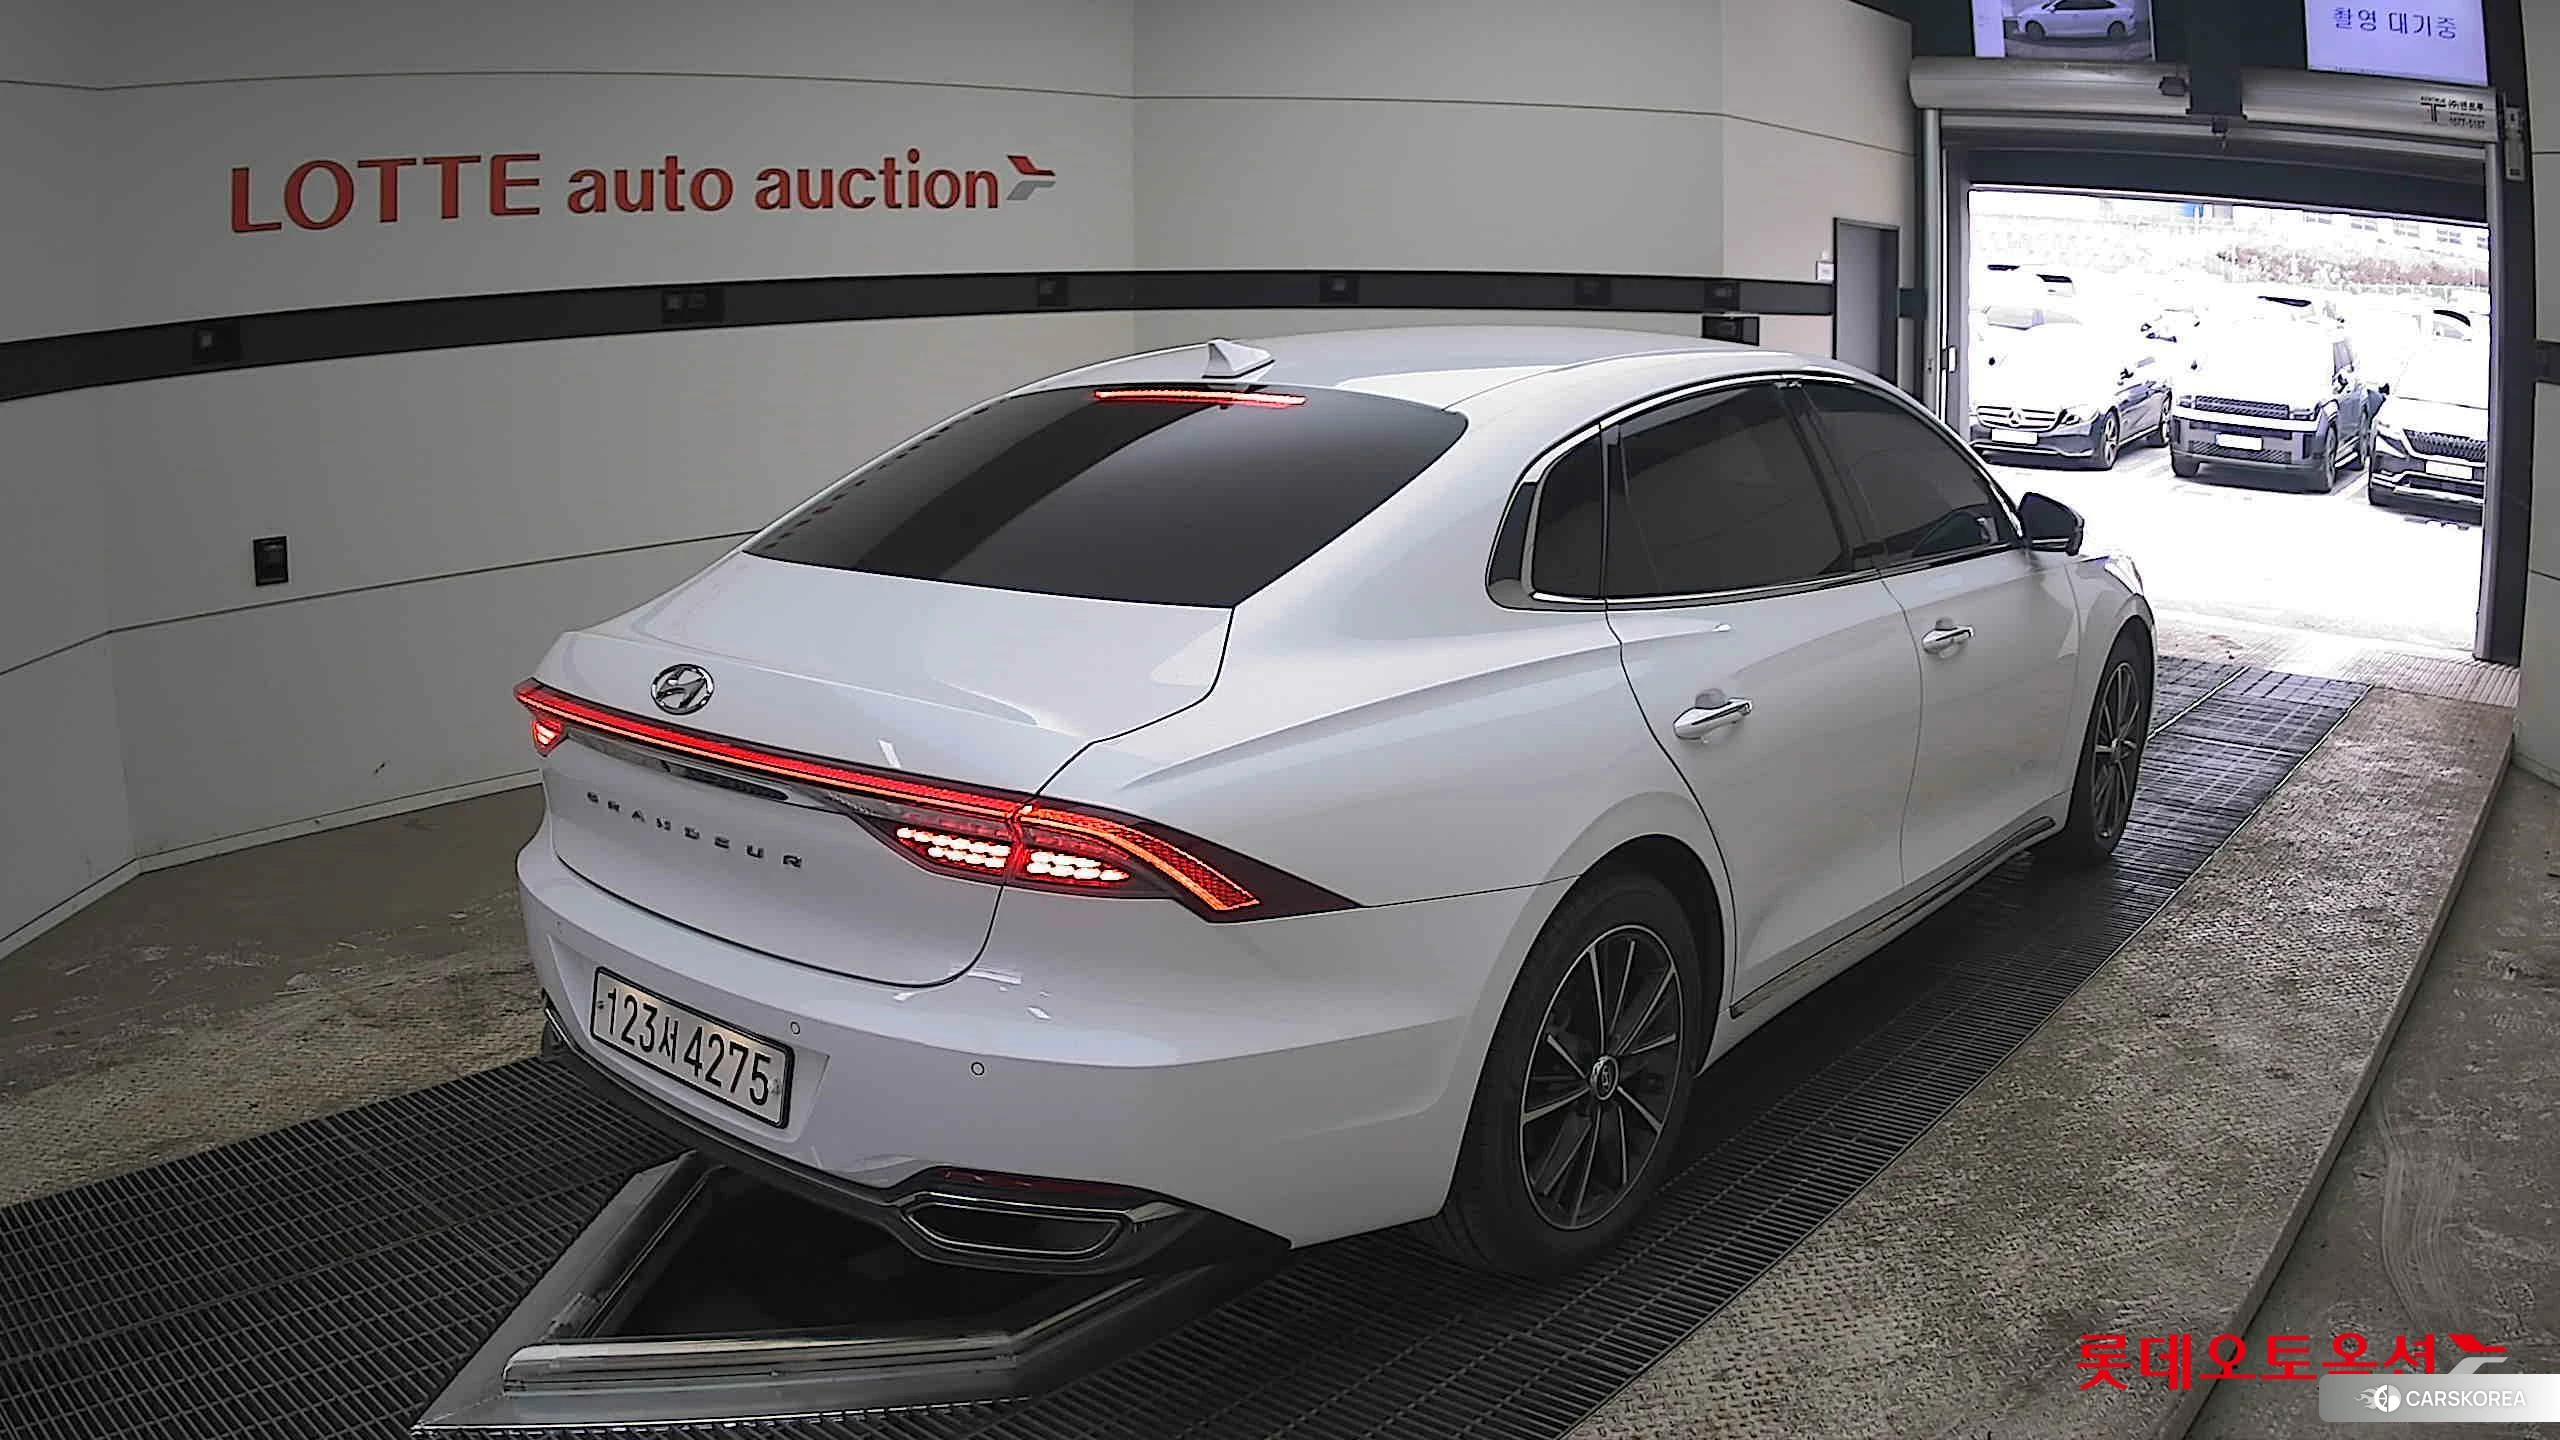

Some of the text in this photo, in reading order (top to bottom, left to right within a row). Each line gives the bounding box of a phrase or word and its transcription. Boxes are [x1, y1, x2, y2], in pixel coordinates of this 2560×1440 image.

[2388, 12, 2457, 40] 대기중
[231, 154, 1001, 233] LOTTE auto auction
